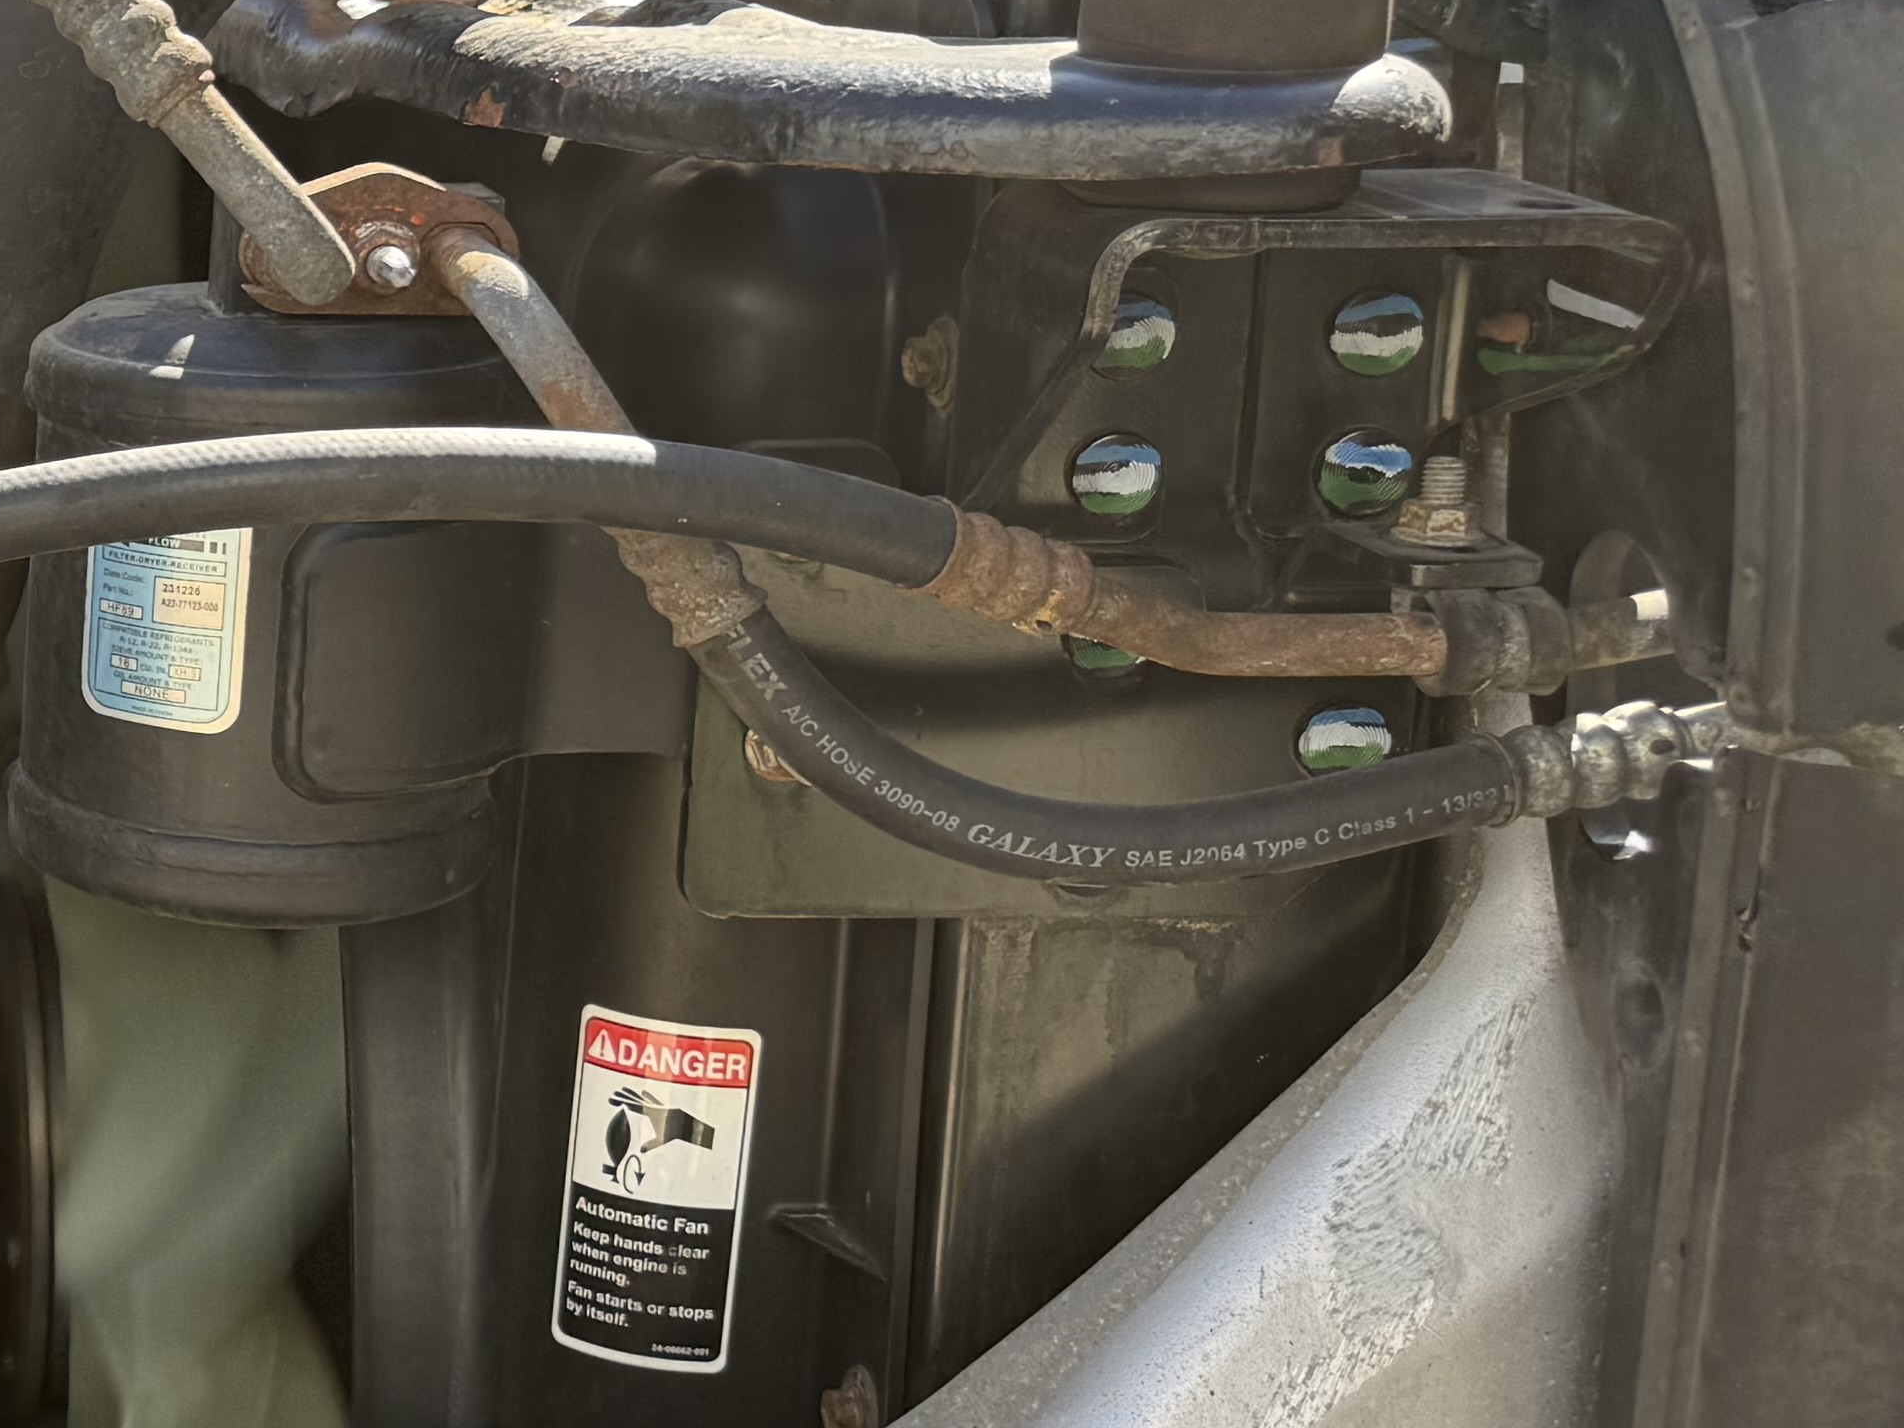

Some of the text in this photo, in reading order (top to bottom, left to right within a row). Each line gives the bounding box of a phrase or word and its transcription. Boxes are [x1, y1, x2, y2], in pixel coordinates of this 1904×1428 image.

[134, 684, 171, 701] NONE
[781, 704, 820, 738] A/C
[815, 733, 876, 786] HOSE
[873, 779, 961, 833] 3090-08
[966, 823, 1117, 868] GALAXY
[1124, 849, 1174, 868] SAE
[1252, 835, 1308, 860] Type
[1313, 827, 1331, 847] C
[617, 1036, 747, 1081] DANGER
[574, 1195, 710, 1236] Automatic Fan
[571, 1240, 688, 1277] when engine is
[573, 1220, 710, 1261] Keep hands clear
[569, 1259, 631, 1288] running.
[566, 1296, 584, 1319] by
[567, 1280, 715, 1324] Fan starts or stops
